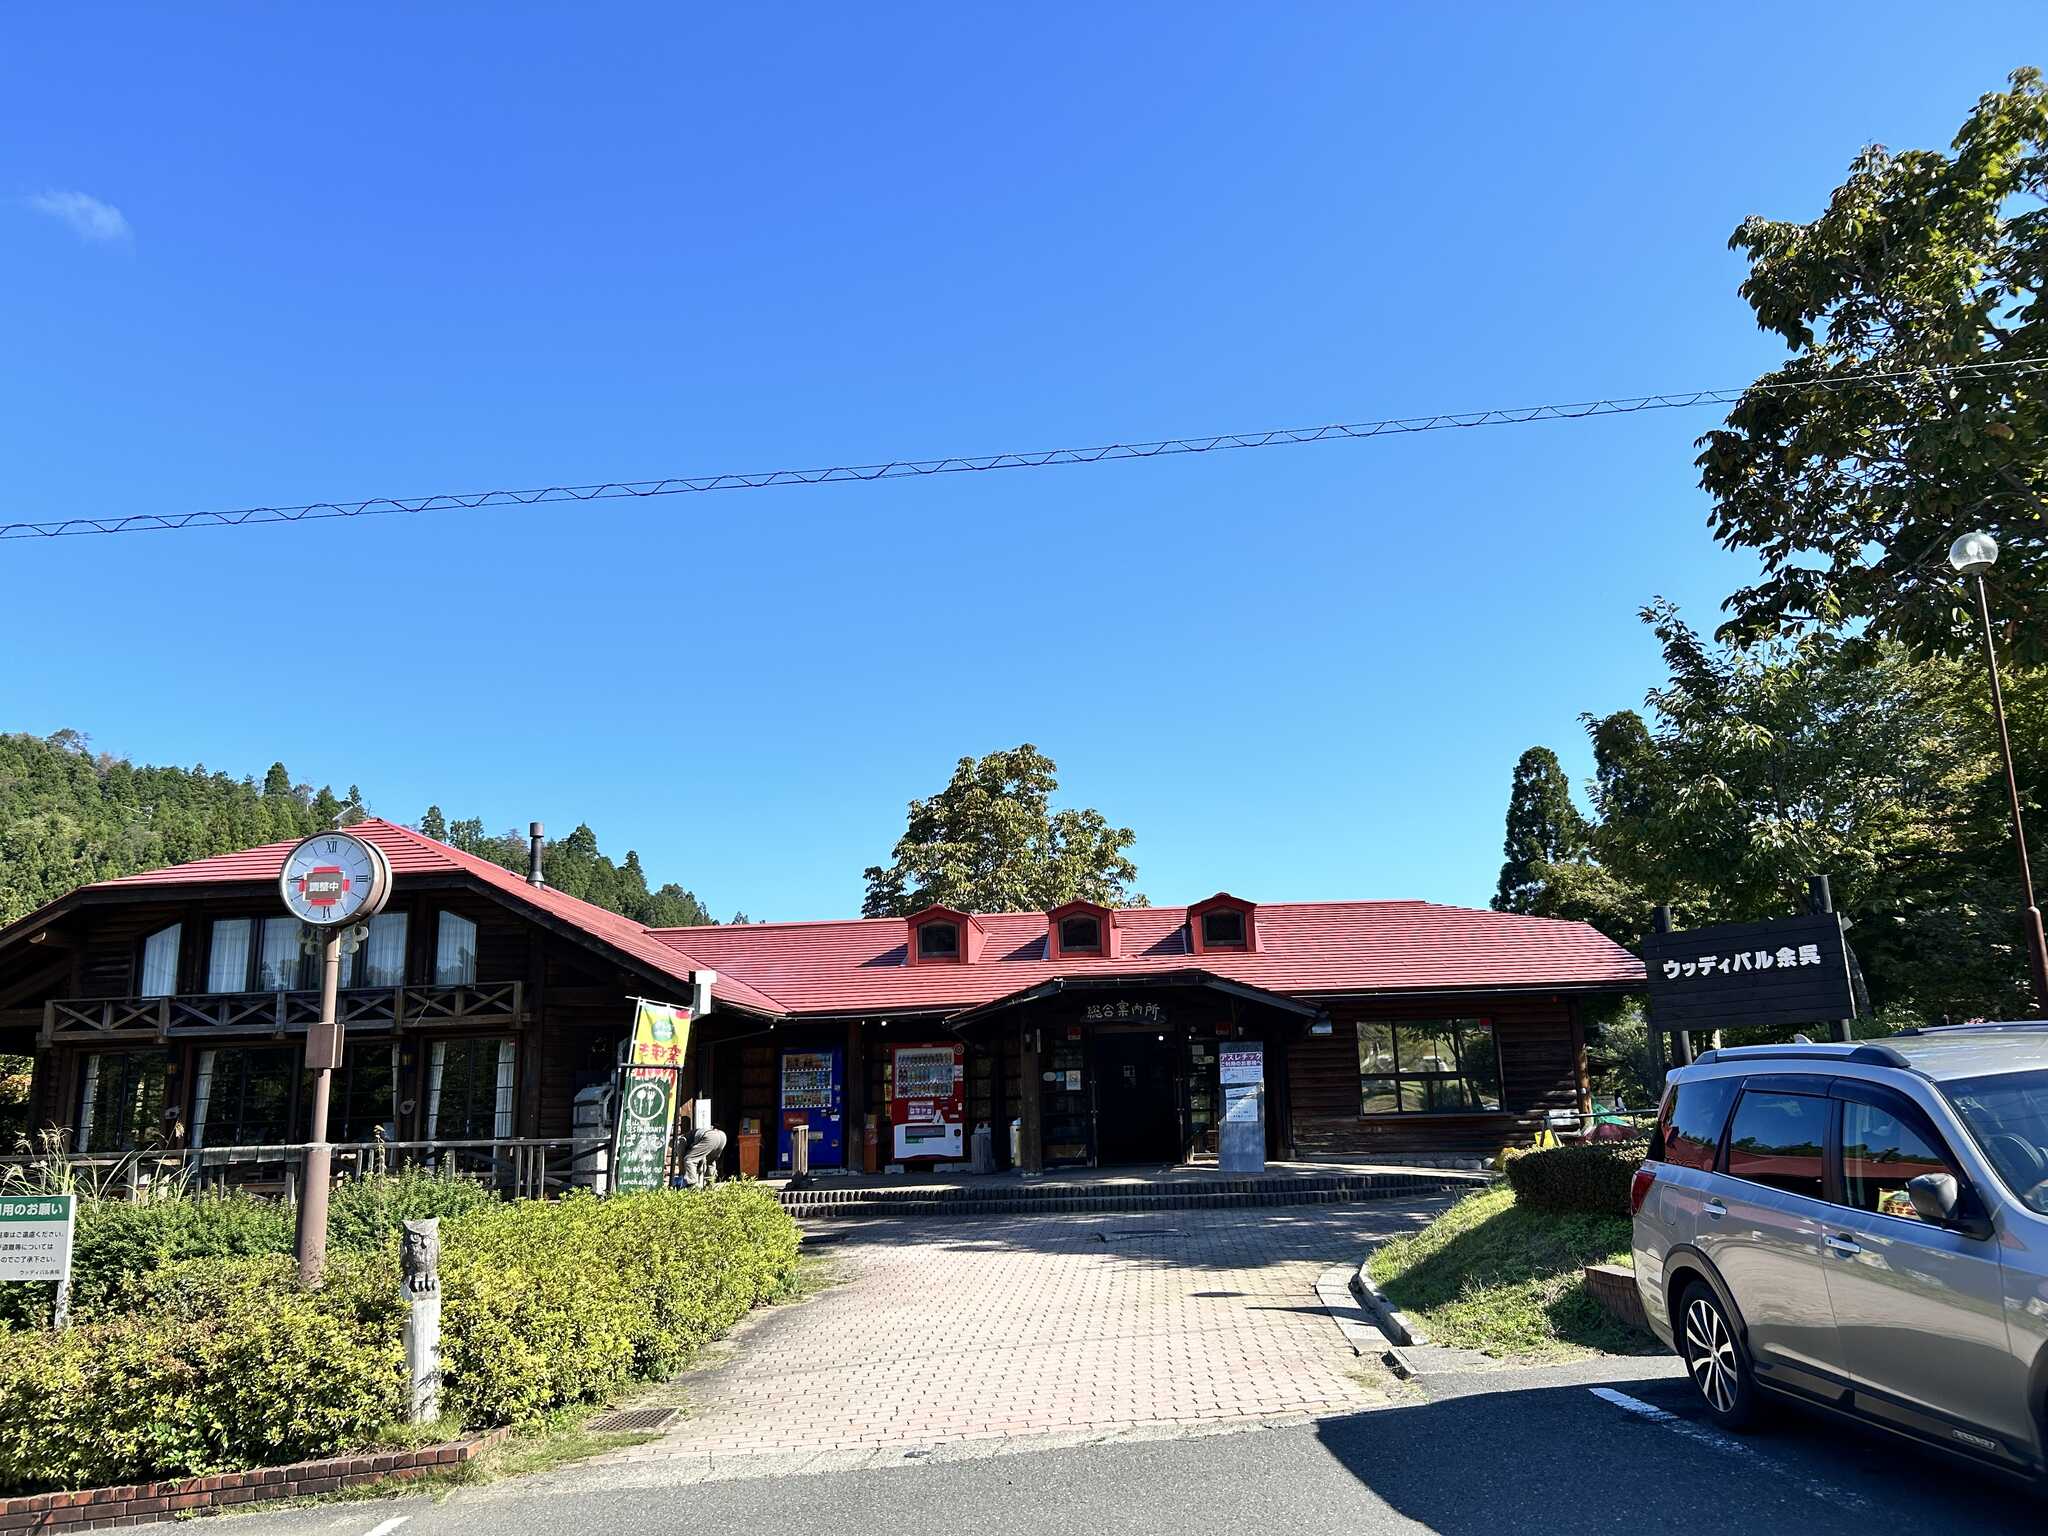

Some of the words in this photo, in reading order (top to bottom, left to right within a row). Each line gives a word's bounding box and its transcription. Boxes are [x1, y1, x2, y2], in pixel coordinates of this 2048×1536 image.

[1662, 944, 1821, 980] ウッディパル余呉
[1087, 1000, 1161, 1021] 総合案内所
[0, 1203, 63, 1216] 用のお願い
